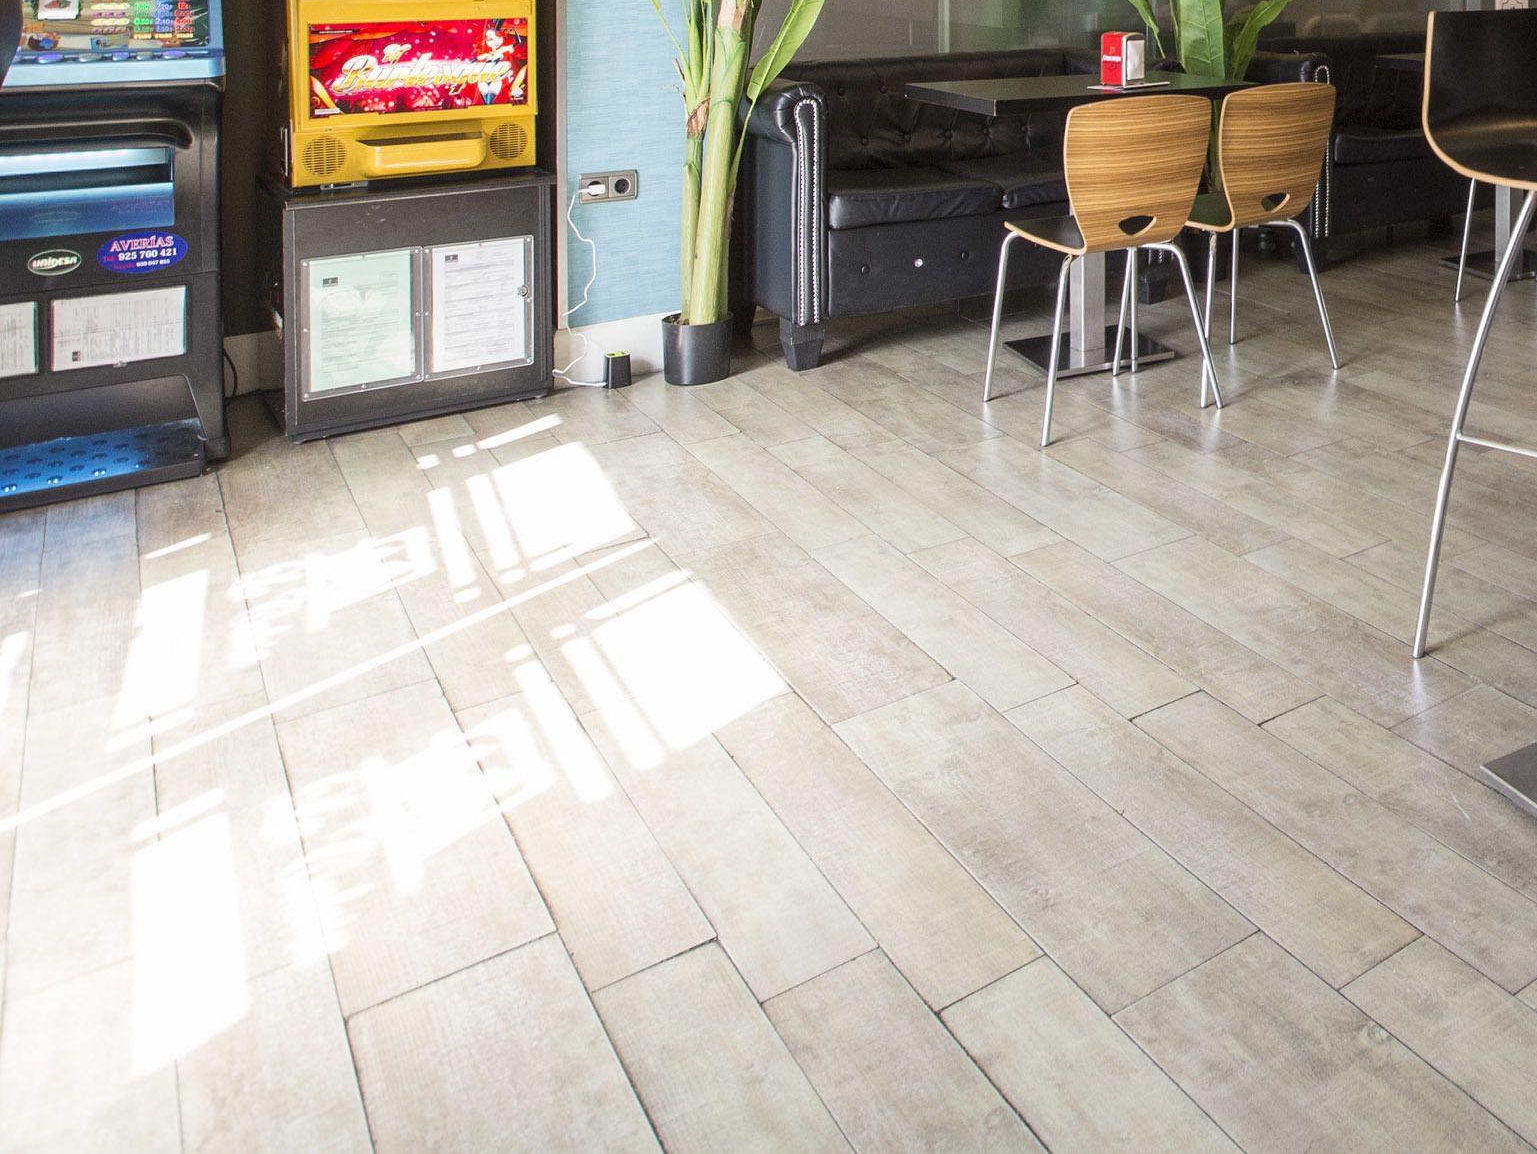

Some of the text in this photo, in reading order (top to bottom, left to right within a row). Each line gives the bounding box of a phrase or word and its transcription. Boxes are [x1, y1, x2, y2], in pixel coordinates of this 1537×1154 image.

[331, 52, 511, 96] Burlesque
[110, 235, 175, 253] AVERÍAS
[118, 251, 137, 262] 925
[139, 249, 158, 260] 760
[159, 247, 177, 258] 421
